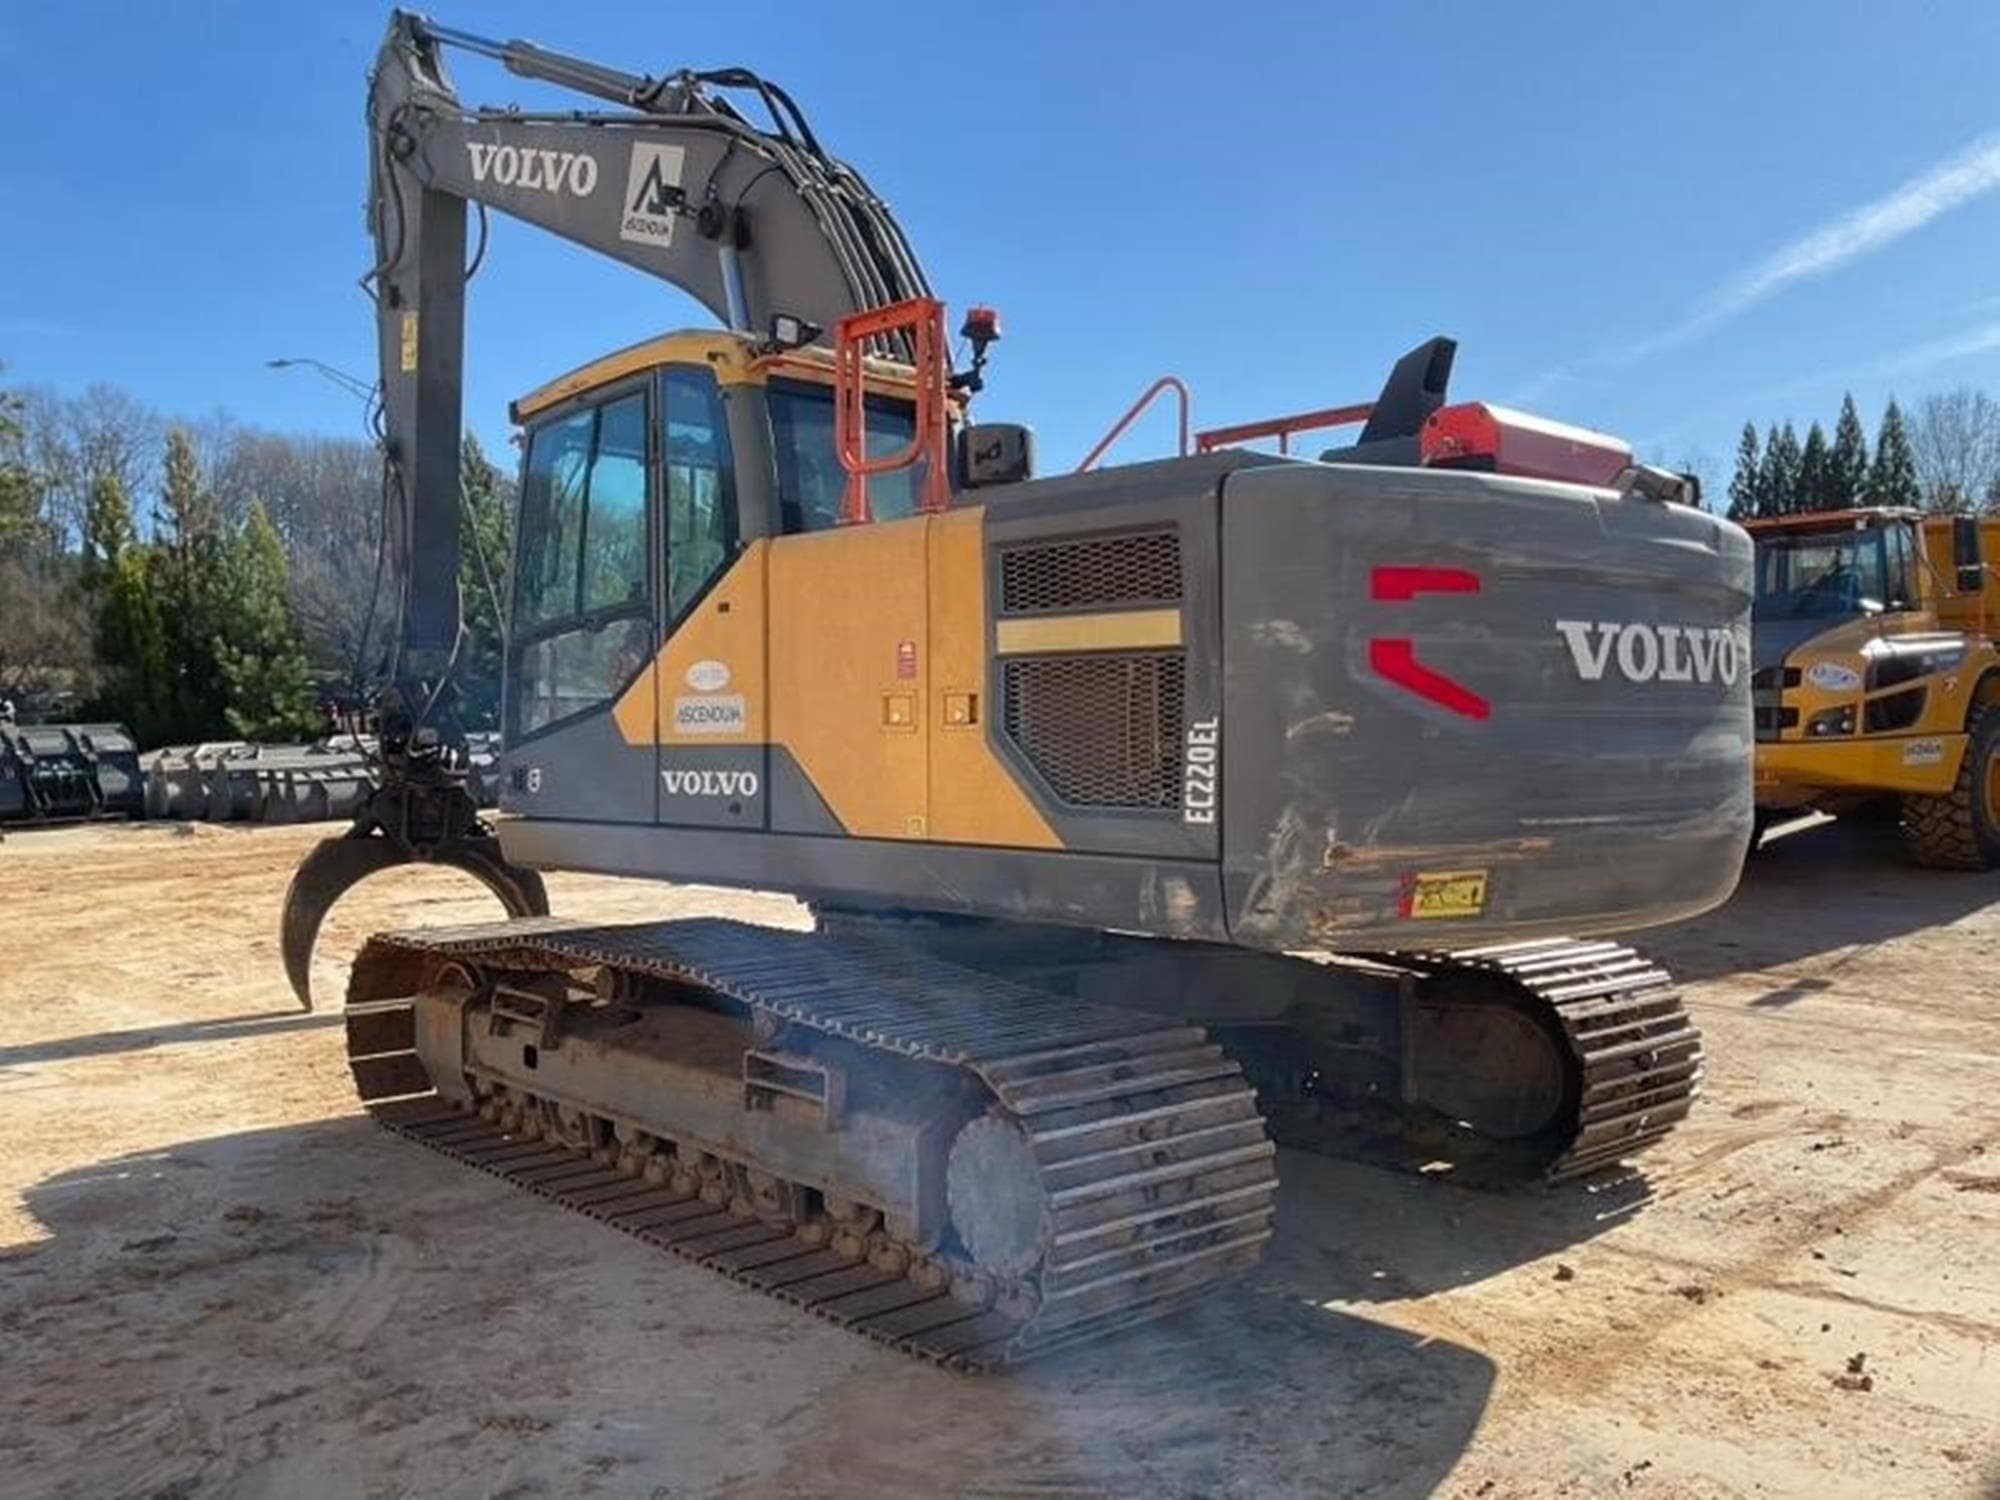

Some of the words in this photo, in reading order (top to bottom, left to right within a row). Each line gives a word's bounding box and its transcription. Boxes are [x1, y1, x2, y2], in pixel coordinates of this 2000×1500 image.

[466, 142, 598, 197] VOLVO
[1555, 619, 1738, 686] VOLVO
[661, 770, 758, 797] VOLVO
[1184, 716, 1218, 823] EC220EL
